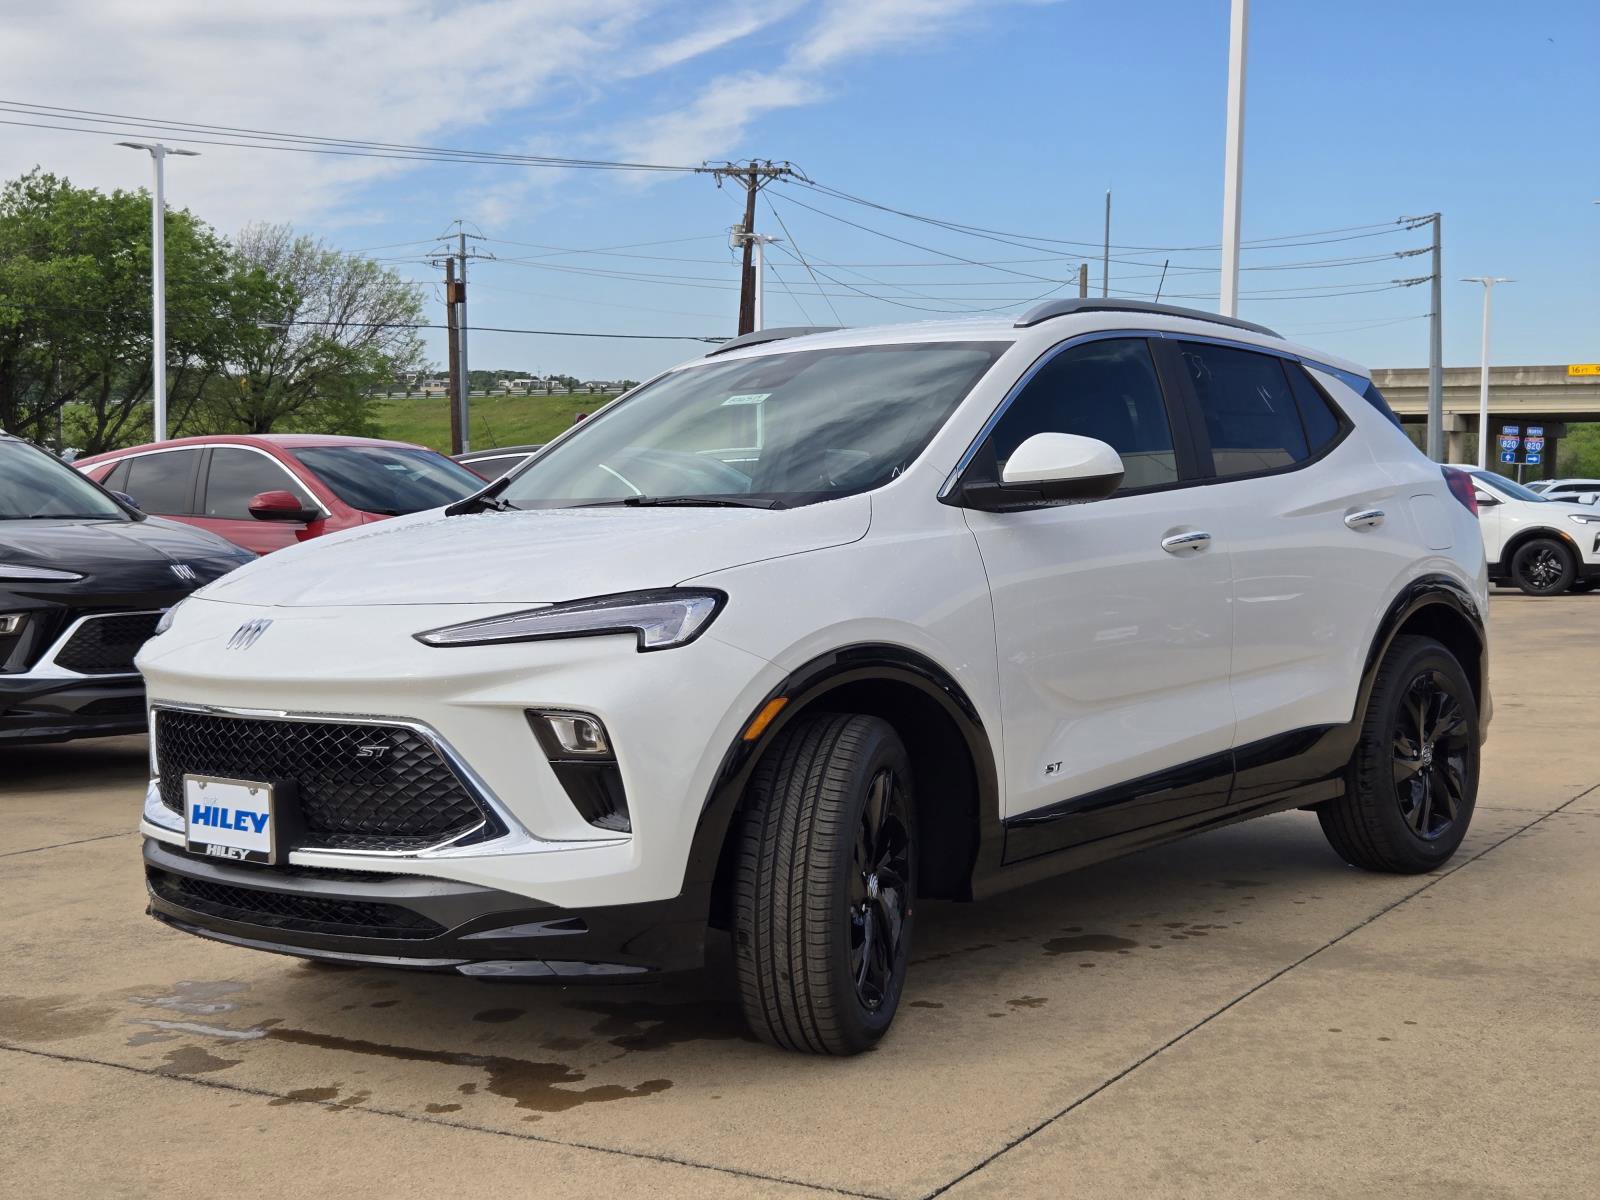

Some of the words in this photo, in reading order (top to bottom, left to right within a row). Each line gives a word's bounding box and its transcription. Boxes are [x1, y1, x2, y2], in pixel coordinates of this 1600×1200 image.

[356, 746, 390, 757] ST
[1045, 761, 1063, 774] ST
[191, 804, 270, 834] HILEY
[206, 843, 252, 861] HILEY
